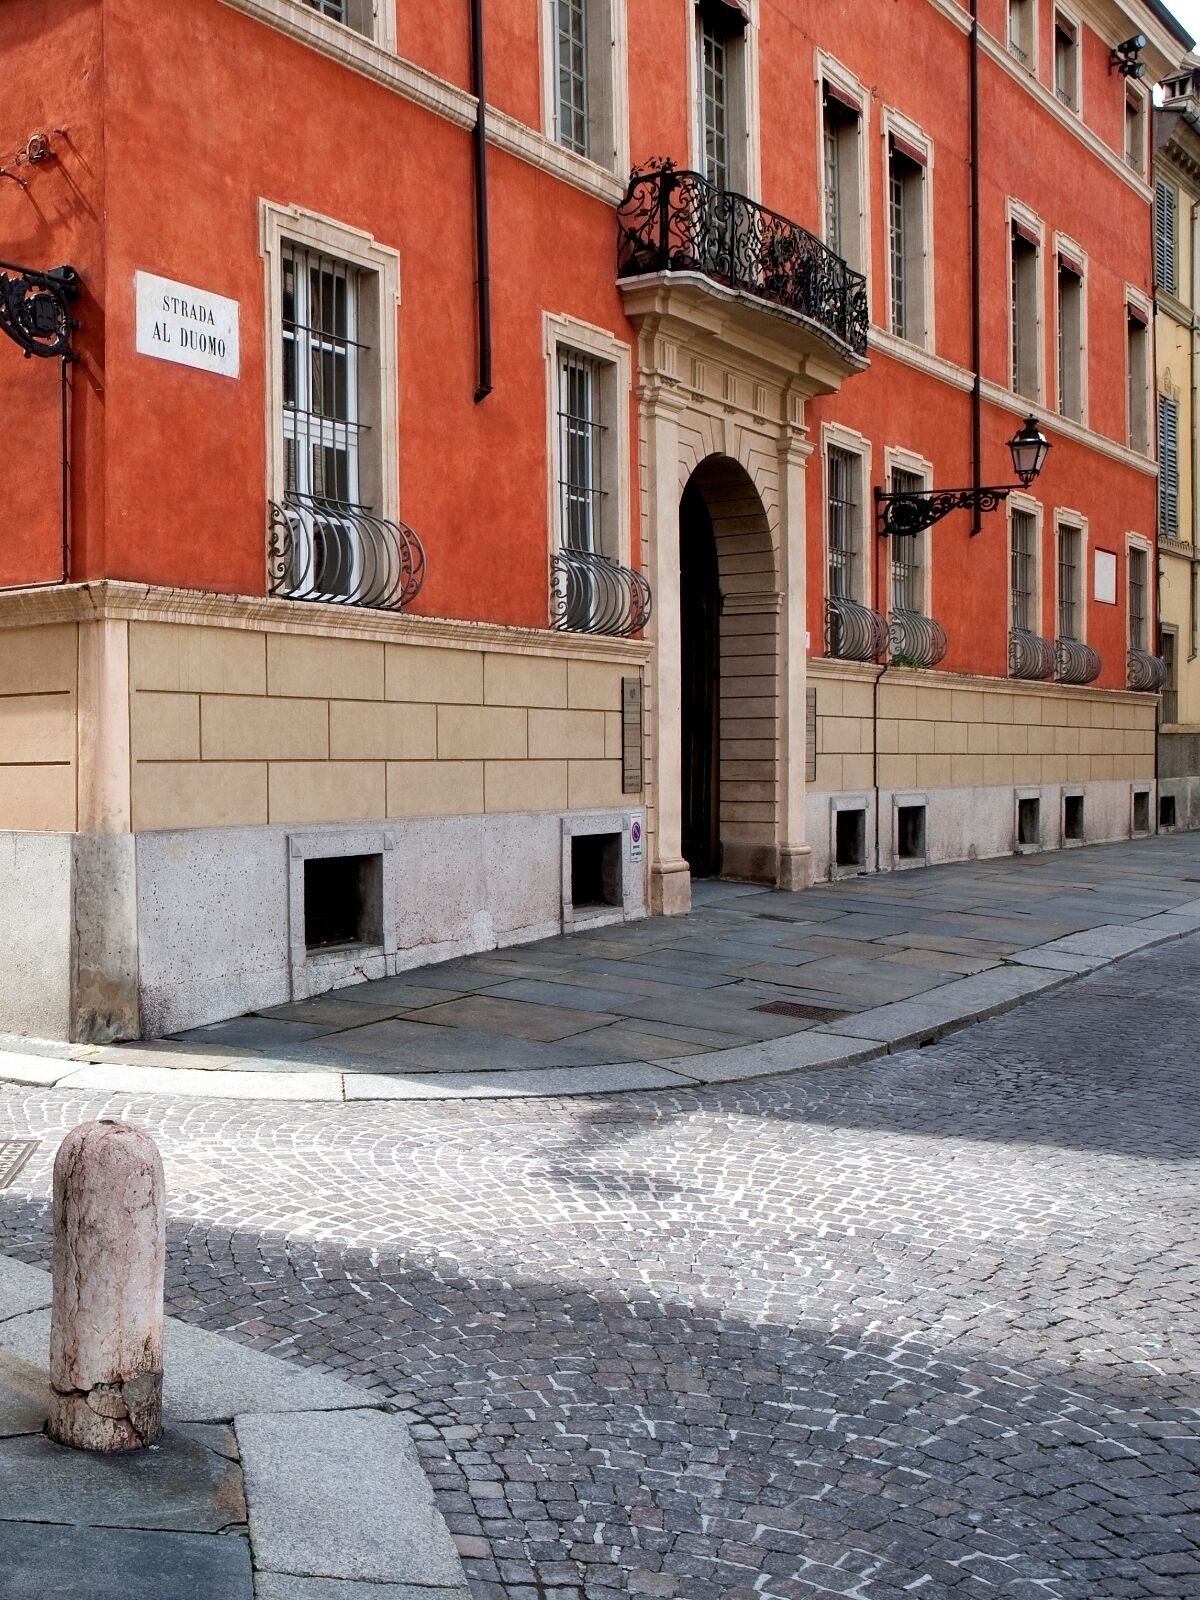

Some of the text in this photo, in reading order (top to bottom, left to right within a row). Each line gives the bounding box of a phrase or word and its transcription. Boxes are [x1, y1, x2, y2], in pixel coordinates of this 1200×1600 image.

[162, 295, 215, 326] STRADA
[152, 321, 226, 358] AL DUOMO
